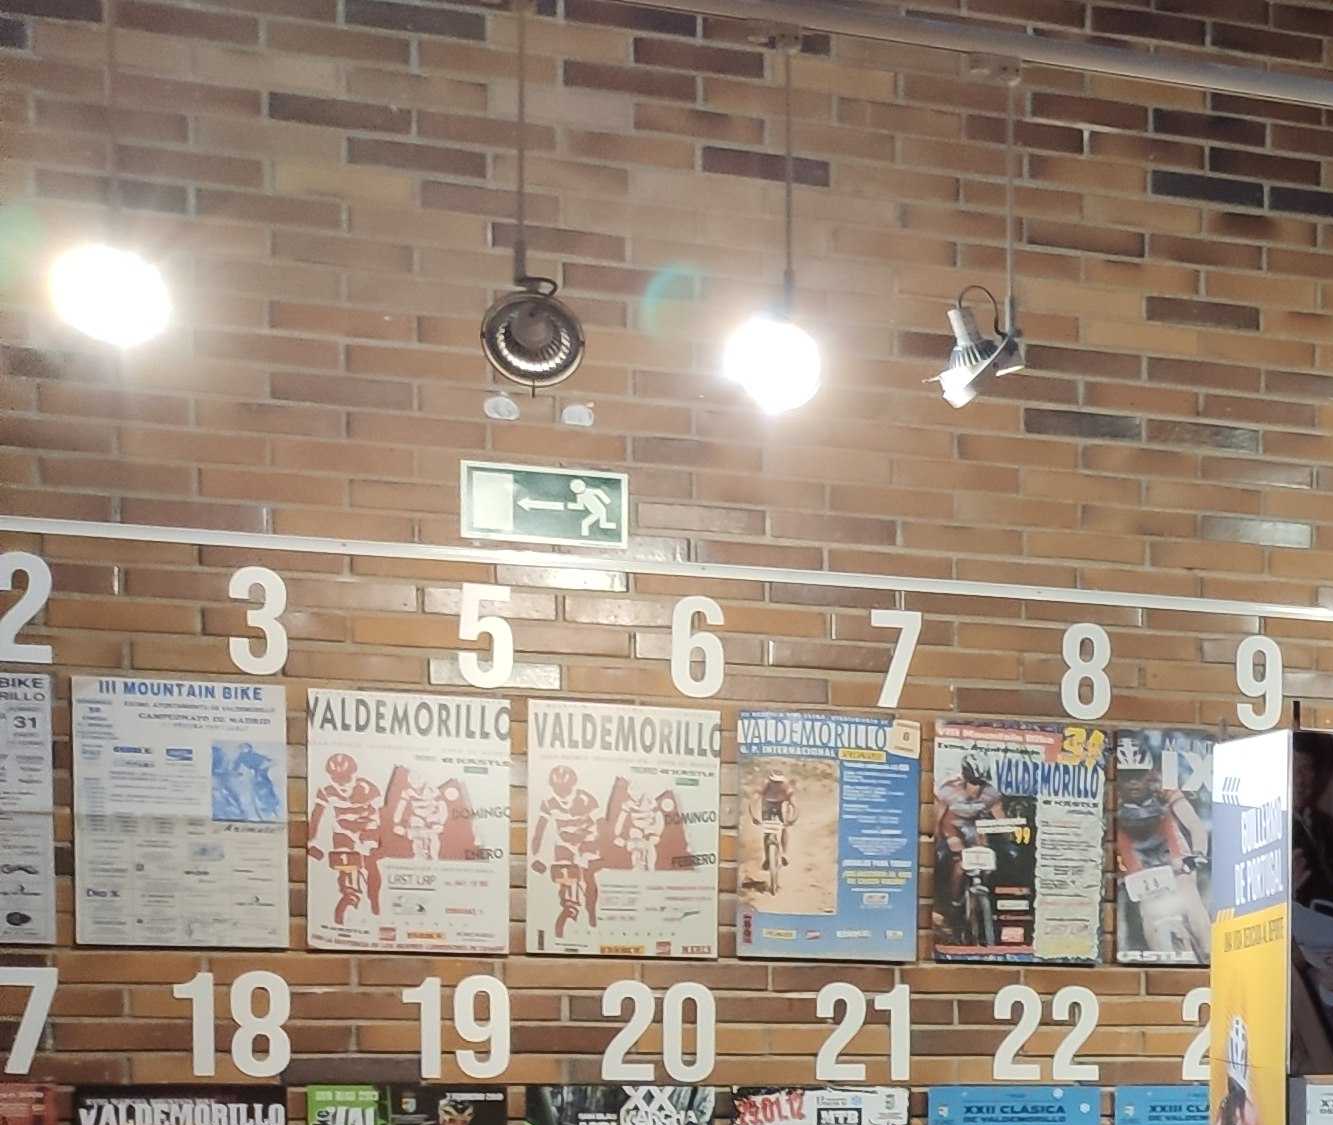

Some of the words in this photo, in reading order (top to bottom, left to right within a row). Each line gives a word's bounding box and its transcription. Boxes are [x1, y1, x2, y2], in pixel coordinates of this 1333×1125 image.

[0, 552, 53, 664] 2
[228, 566, 288, 675] 3
[457, 583, 515, 689] 5
[670, 595, 725, 698] 6
[99, 680, 116, 695] III
[123, 681, 216, 699] MOUNTAIN
[222, 686, 263, 701] BIKE
[869, 609, 922, 708] 7
[1060, 622, 1112, 720] 8
[1235, 635, 1283, 731] 9
[13, 715, 38, 729] 31
[308, 694, 511, 742] VALDEMORILLO
[534, 711, 720, 759] VALDEMORILLO
[741, 718, 887, 751] VALDEMORILLO
[995, 758, 1100, 800] VALDEMORILLO
[0, 966, 58, 1076] 7
[173, 970, 292, 1078] 18
[402, 975, 512, 1081] 19
[601, 979, 717, 1083] 20
[815, 981, 911, 1083] 21
[993, 984, 1100, 1083] 22
[1182, 986, 1211, 1083] 2
[622, 1086, 677, 1113] XX
[963, 1104, 996, 1115] XXII
[1149, 1104, 1183, 1113] XXIII
